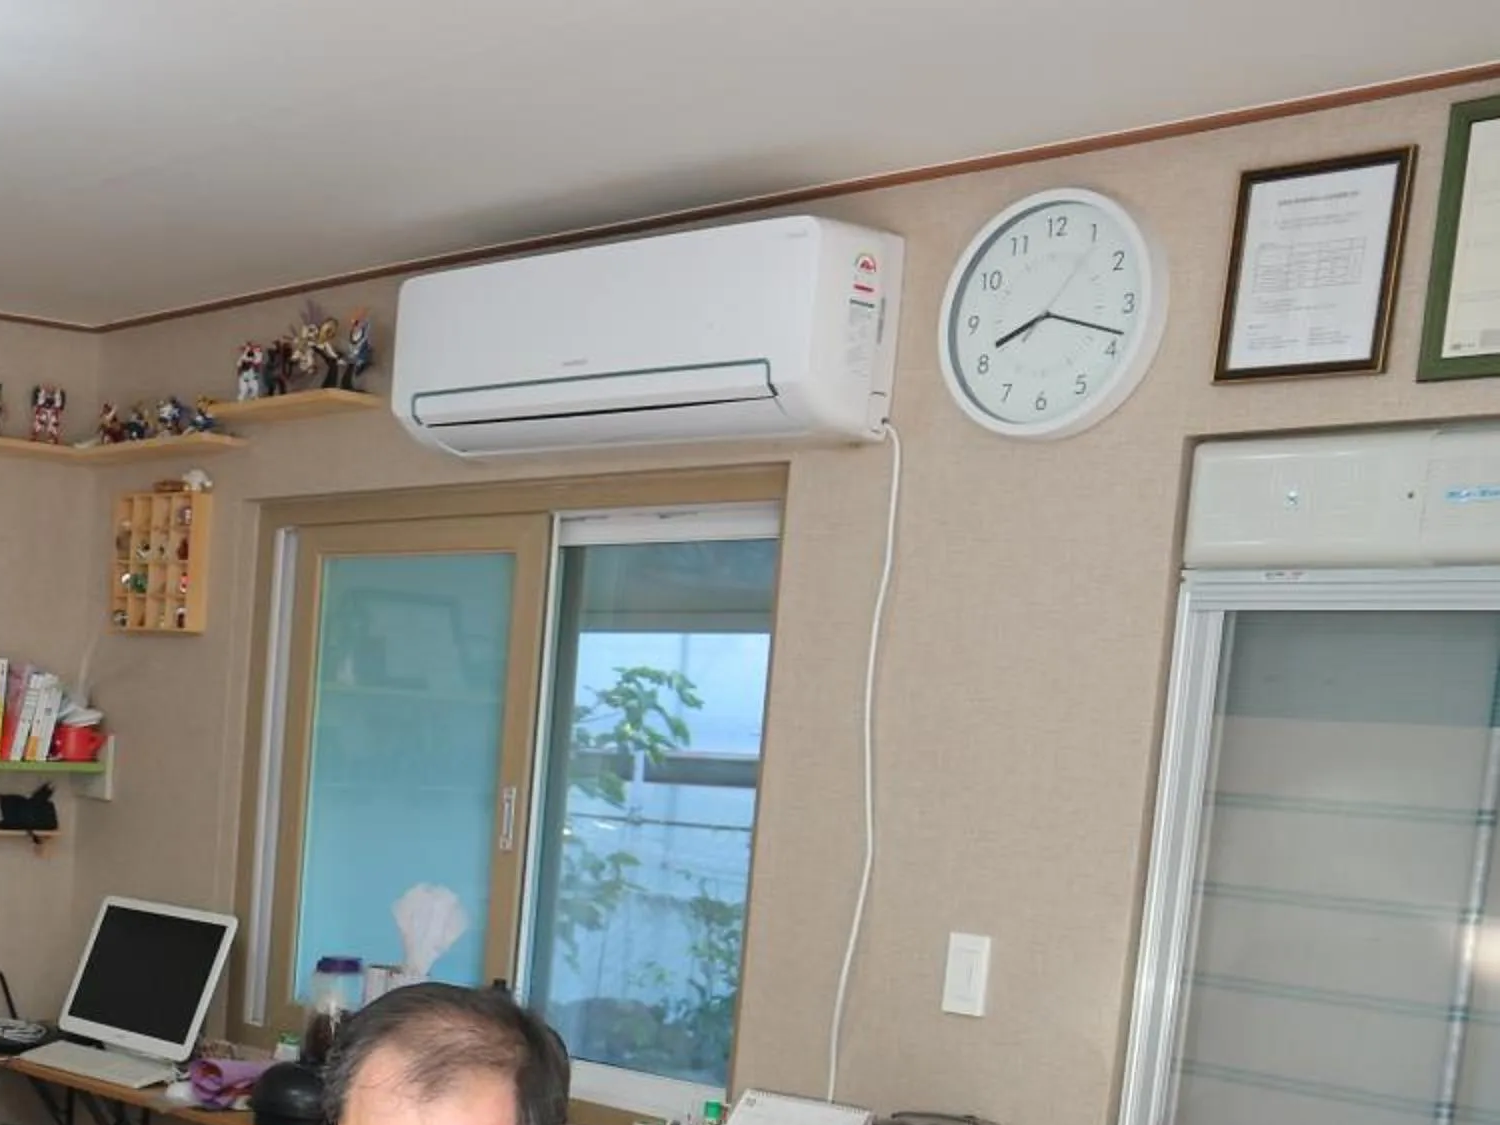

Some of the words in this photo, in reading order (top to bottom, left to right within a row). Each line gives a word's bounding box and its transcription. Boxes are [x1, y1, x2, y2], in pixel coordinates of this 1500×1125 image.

[1047, 216, 1068, 238] 12
[1090, 223, 1098, 243] 1
[1010, 235, 1030, 256] 11
[1111, 250, 1125, 272] 2
[981, 270, 1003, 291] 10
[1122, 293, 1135, 315] 3
[967, 315, 980, 335] 9
[1104, 339, 1117, 358] 4
[976, 353, 990, 374] 8
[1001, 383, 1013, 402] 7
[1074, 374, 1088, 395] 5
[1035, 391, 1047, 411] 6
